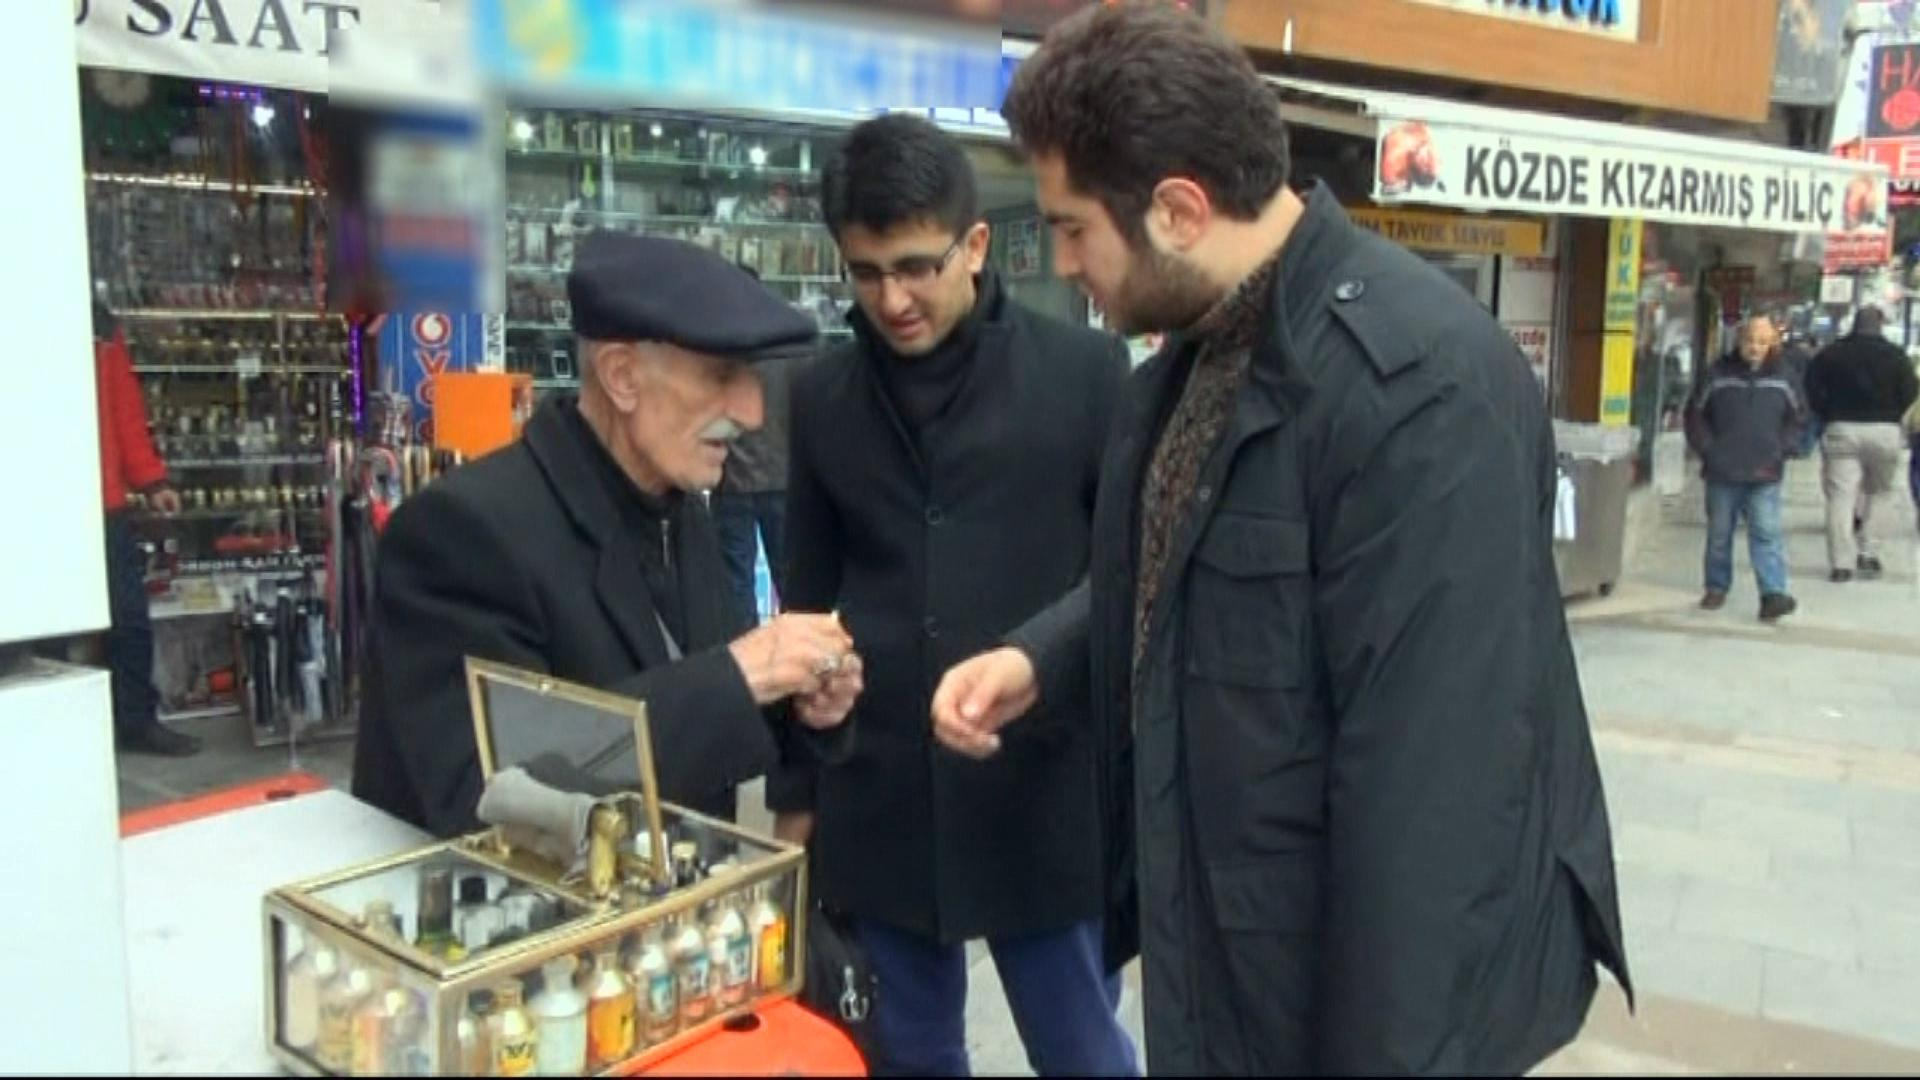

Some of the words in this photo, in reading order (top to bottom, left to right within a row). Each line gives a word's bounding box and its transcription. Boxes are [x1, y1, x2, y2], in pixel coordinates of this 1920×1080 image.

[127, 0, 360, 56] SAAT
[1464, 137, 1589, 206] KÖZDE
[1600, 158, 1754, 226] KIZARMIŞ
[1763, 168, 1833, 230] PİLİÇ
